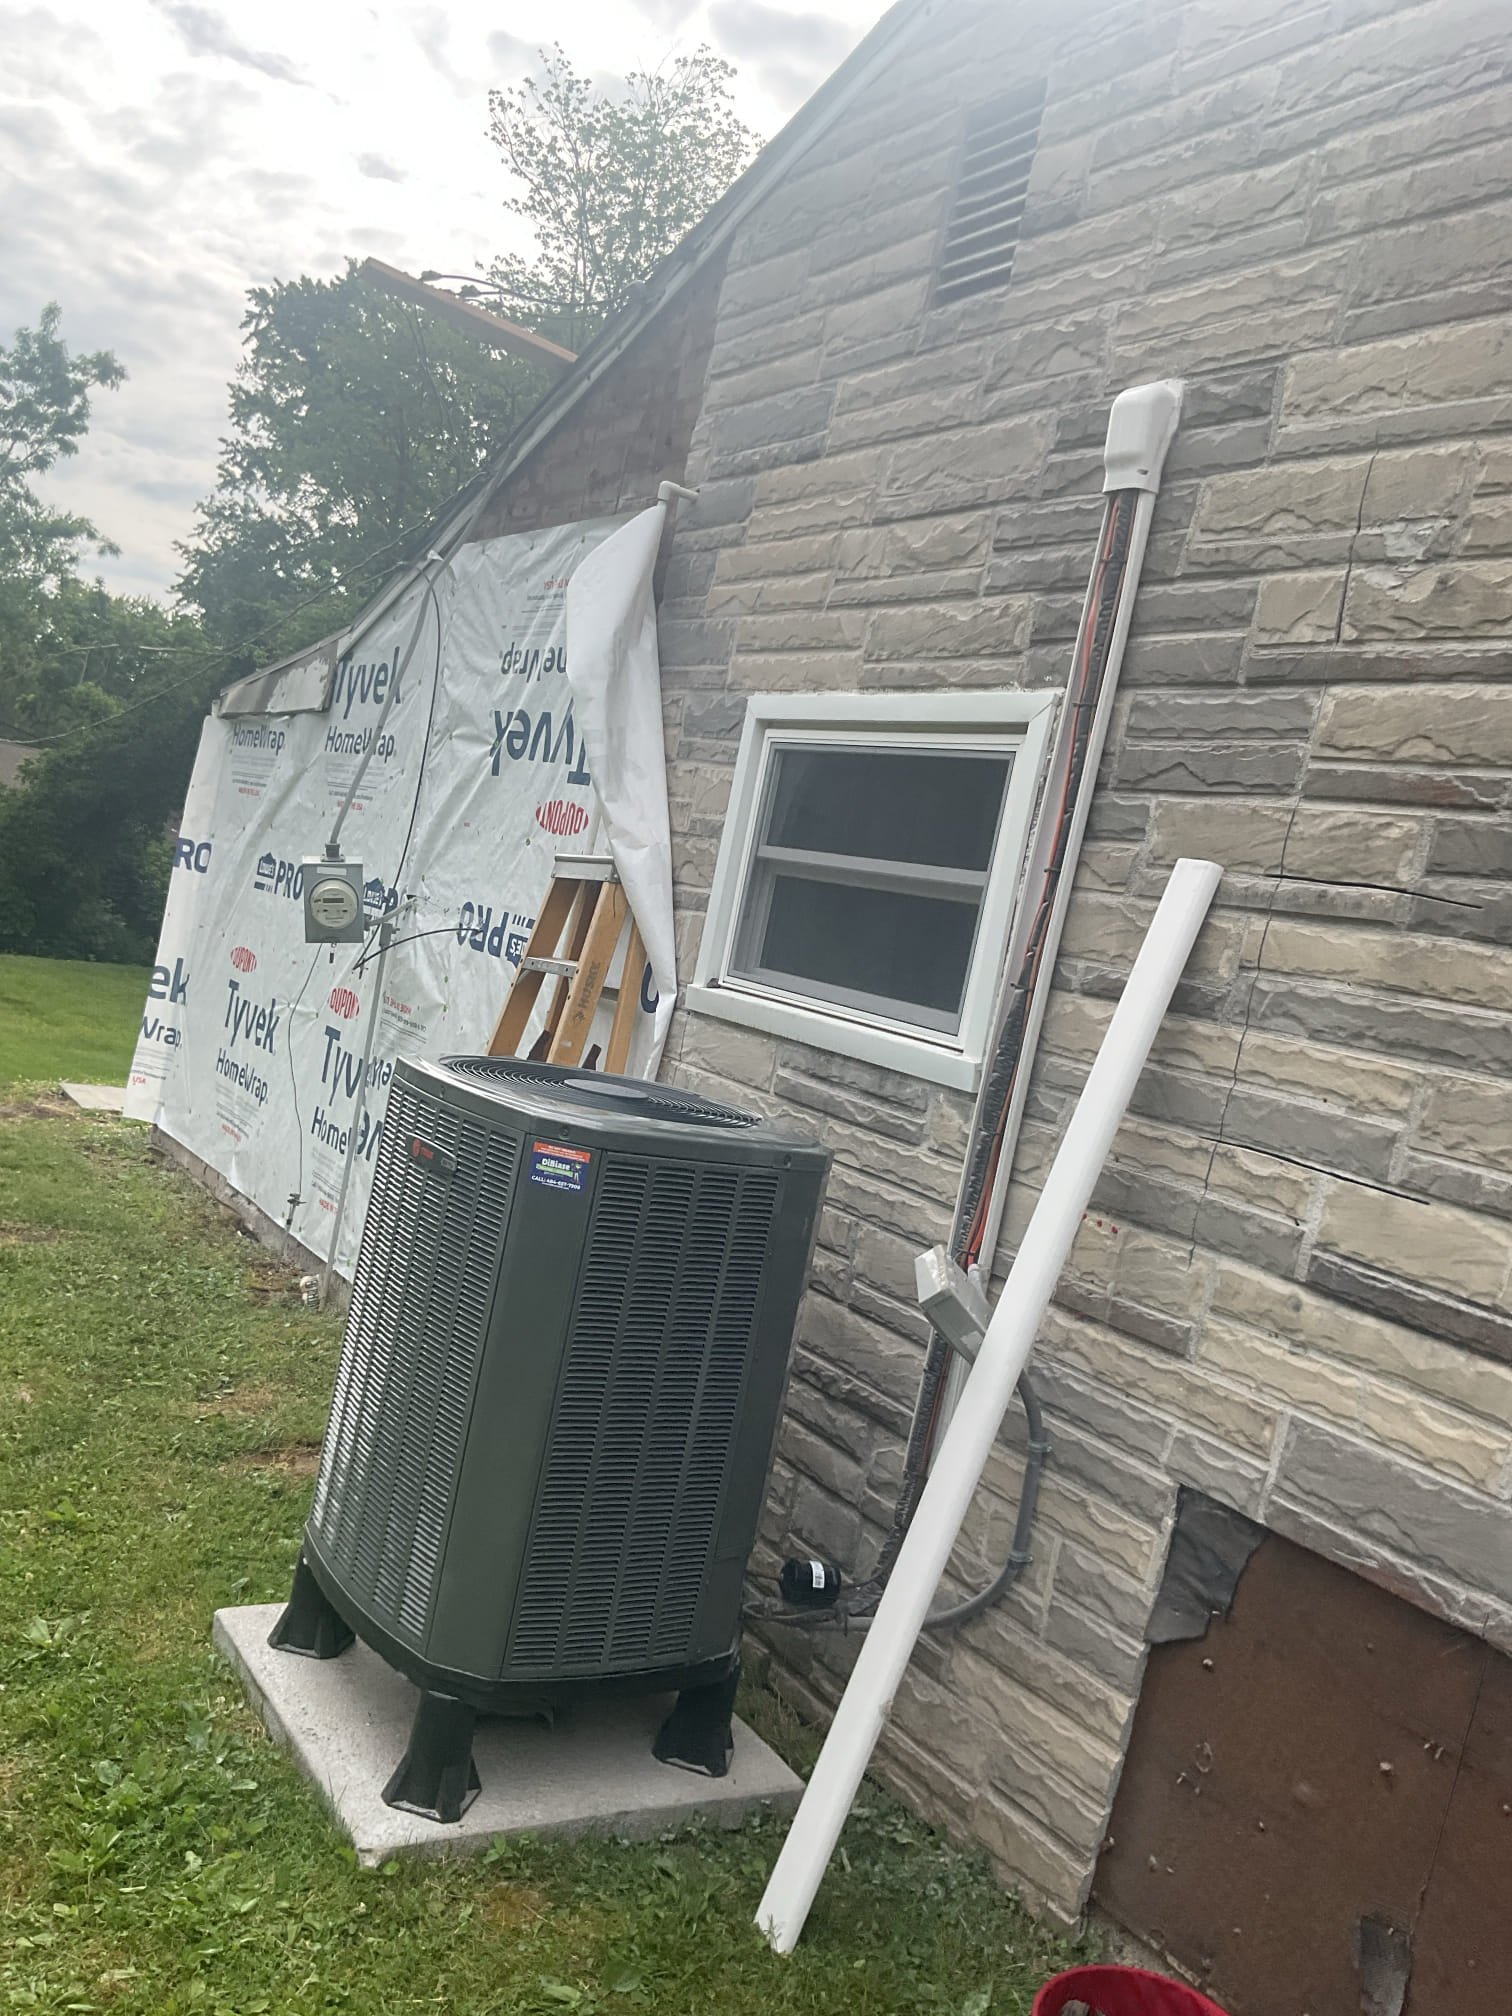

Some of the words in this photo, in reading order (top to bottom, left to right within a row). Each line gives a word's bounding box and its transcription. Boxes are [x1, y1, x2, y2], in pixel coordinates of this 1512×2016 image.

[232, 722, 286, 756] HomeWrap
[489, 697, 591, 787] Tyvek
[537, 799, 589, 836] DUPONT
[174, 837, 212, 873] RO
[274, 860, 304, 900] PRO
[456, 901, 510, 957] PRO
[224, 978, 280, 1054] Tyvek
[216, 1047, 268, 1107] HomeWrap
[321, 1025, 363, 1107] Tyv
